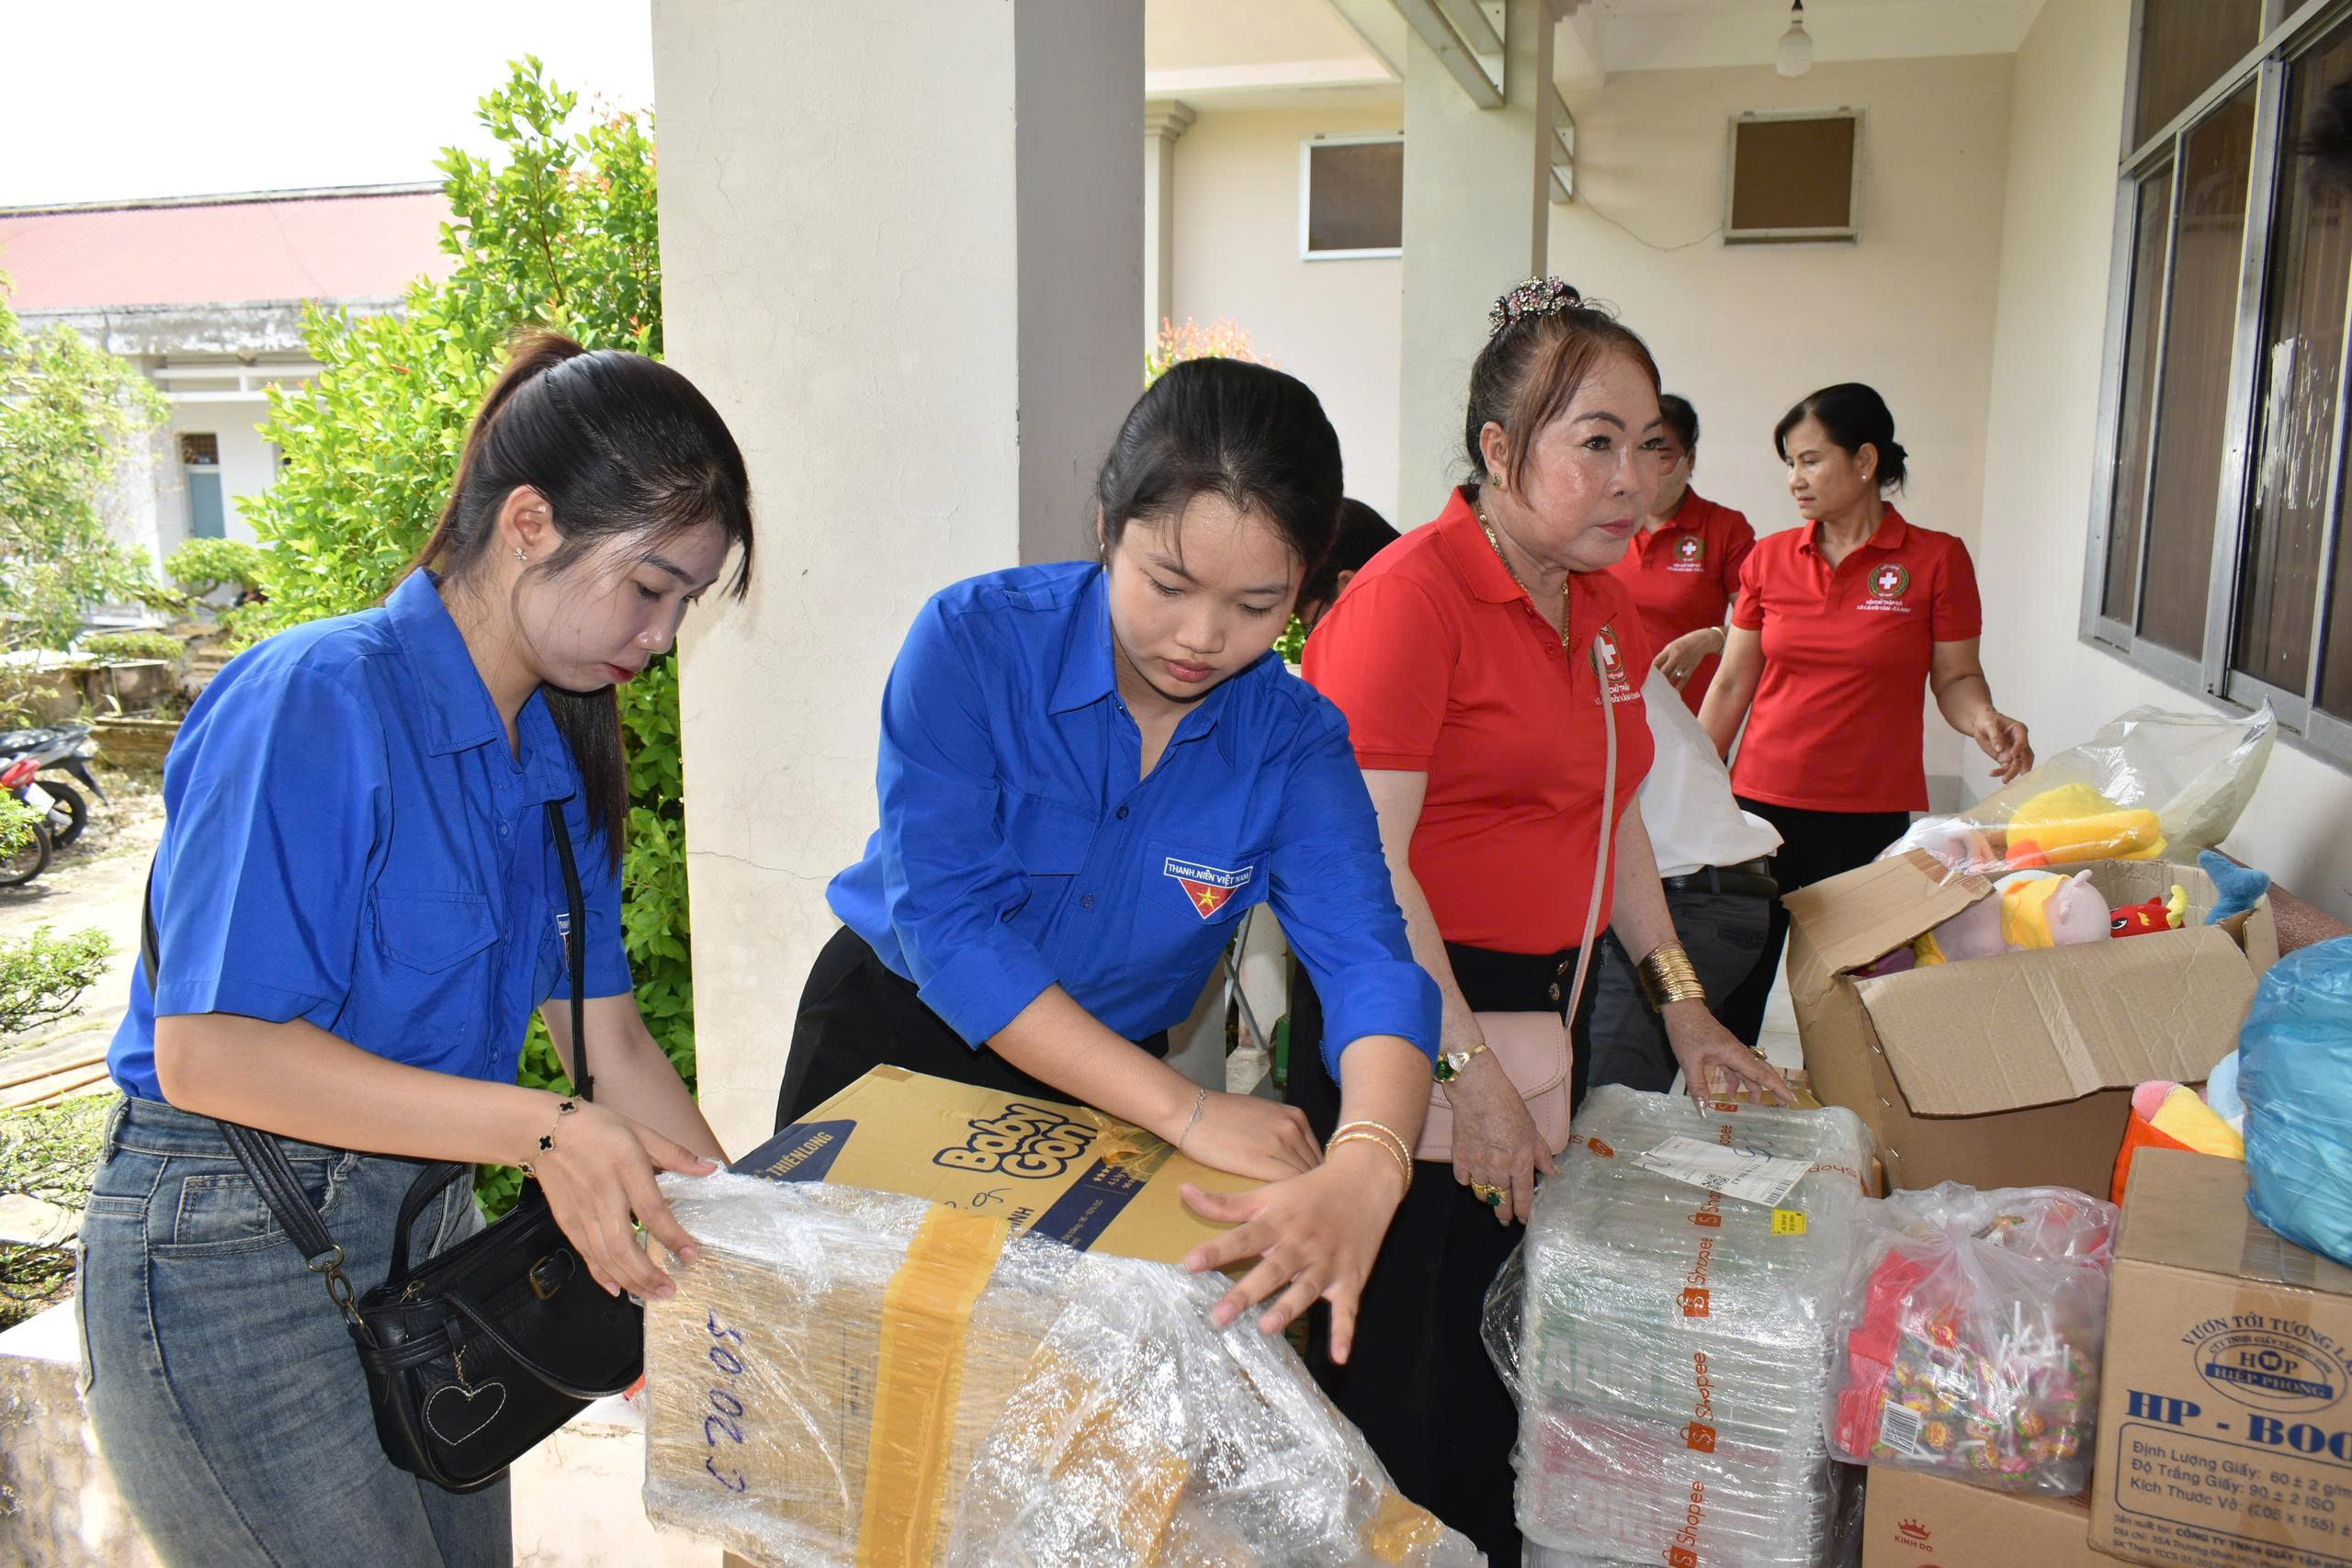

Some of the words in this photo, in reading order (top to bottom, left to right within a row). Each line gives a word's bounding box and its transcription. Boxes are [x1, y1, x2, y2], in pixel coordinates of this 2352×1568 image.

[1168, 863, 1194, 877] THANH
[1196, 869, 1216, 882] NIÊN
[1216, 874, 1235, 887] VIỆT
[1235, 872, 1250, 884] NAM
[1694, 1352, 1715, 1422] Shopee
[2262, 1374, 2326, 1398] PHONG
[2125, 1389, 2202, 1427] HP
[2132, 1440, 2166, 1460] Định
[2170, 1449, 2217, 1472] Lượng
[2270, 1471, 2290, 1485] 60
[2132, 1458, 2153, 1474] Độ
[2158, 1463, 2201, 1487] Trắng
[2249, 1483, 2268, 1498] 90
[2130, 1476, 2162, 1495] Kích
[2166, 1483, 2213, 1506] Thước
[1676, 1480, 1706, 1547] Shopee
[1894, 1533, 1918, 1549] KINH
